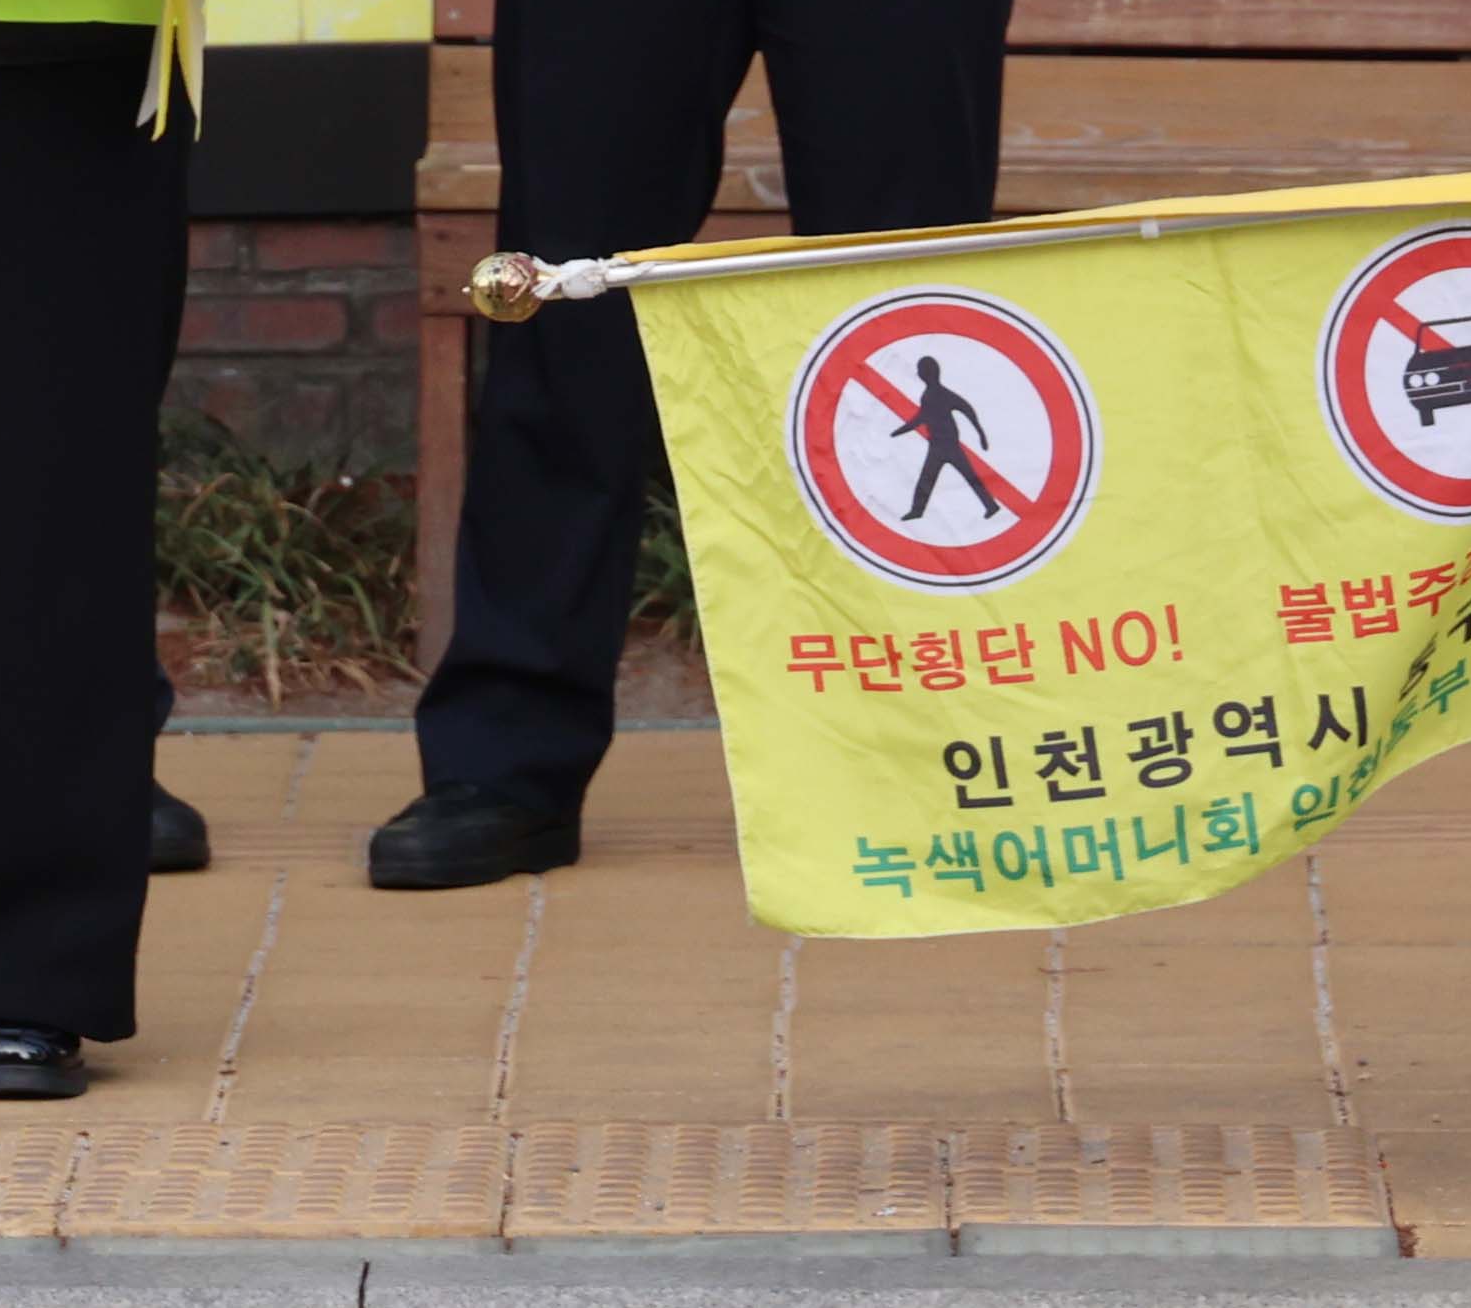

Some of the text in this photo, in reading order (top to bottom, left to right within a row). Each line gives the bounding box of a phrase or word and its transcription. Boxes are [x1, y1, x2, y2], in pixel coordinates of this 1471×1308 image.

[785, 603, 1184, 695] 무단횡단 NO!
[940, 686, 1369, 812] 인천광역시
[851, 791, 1261, 900] 녹색어머니회
